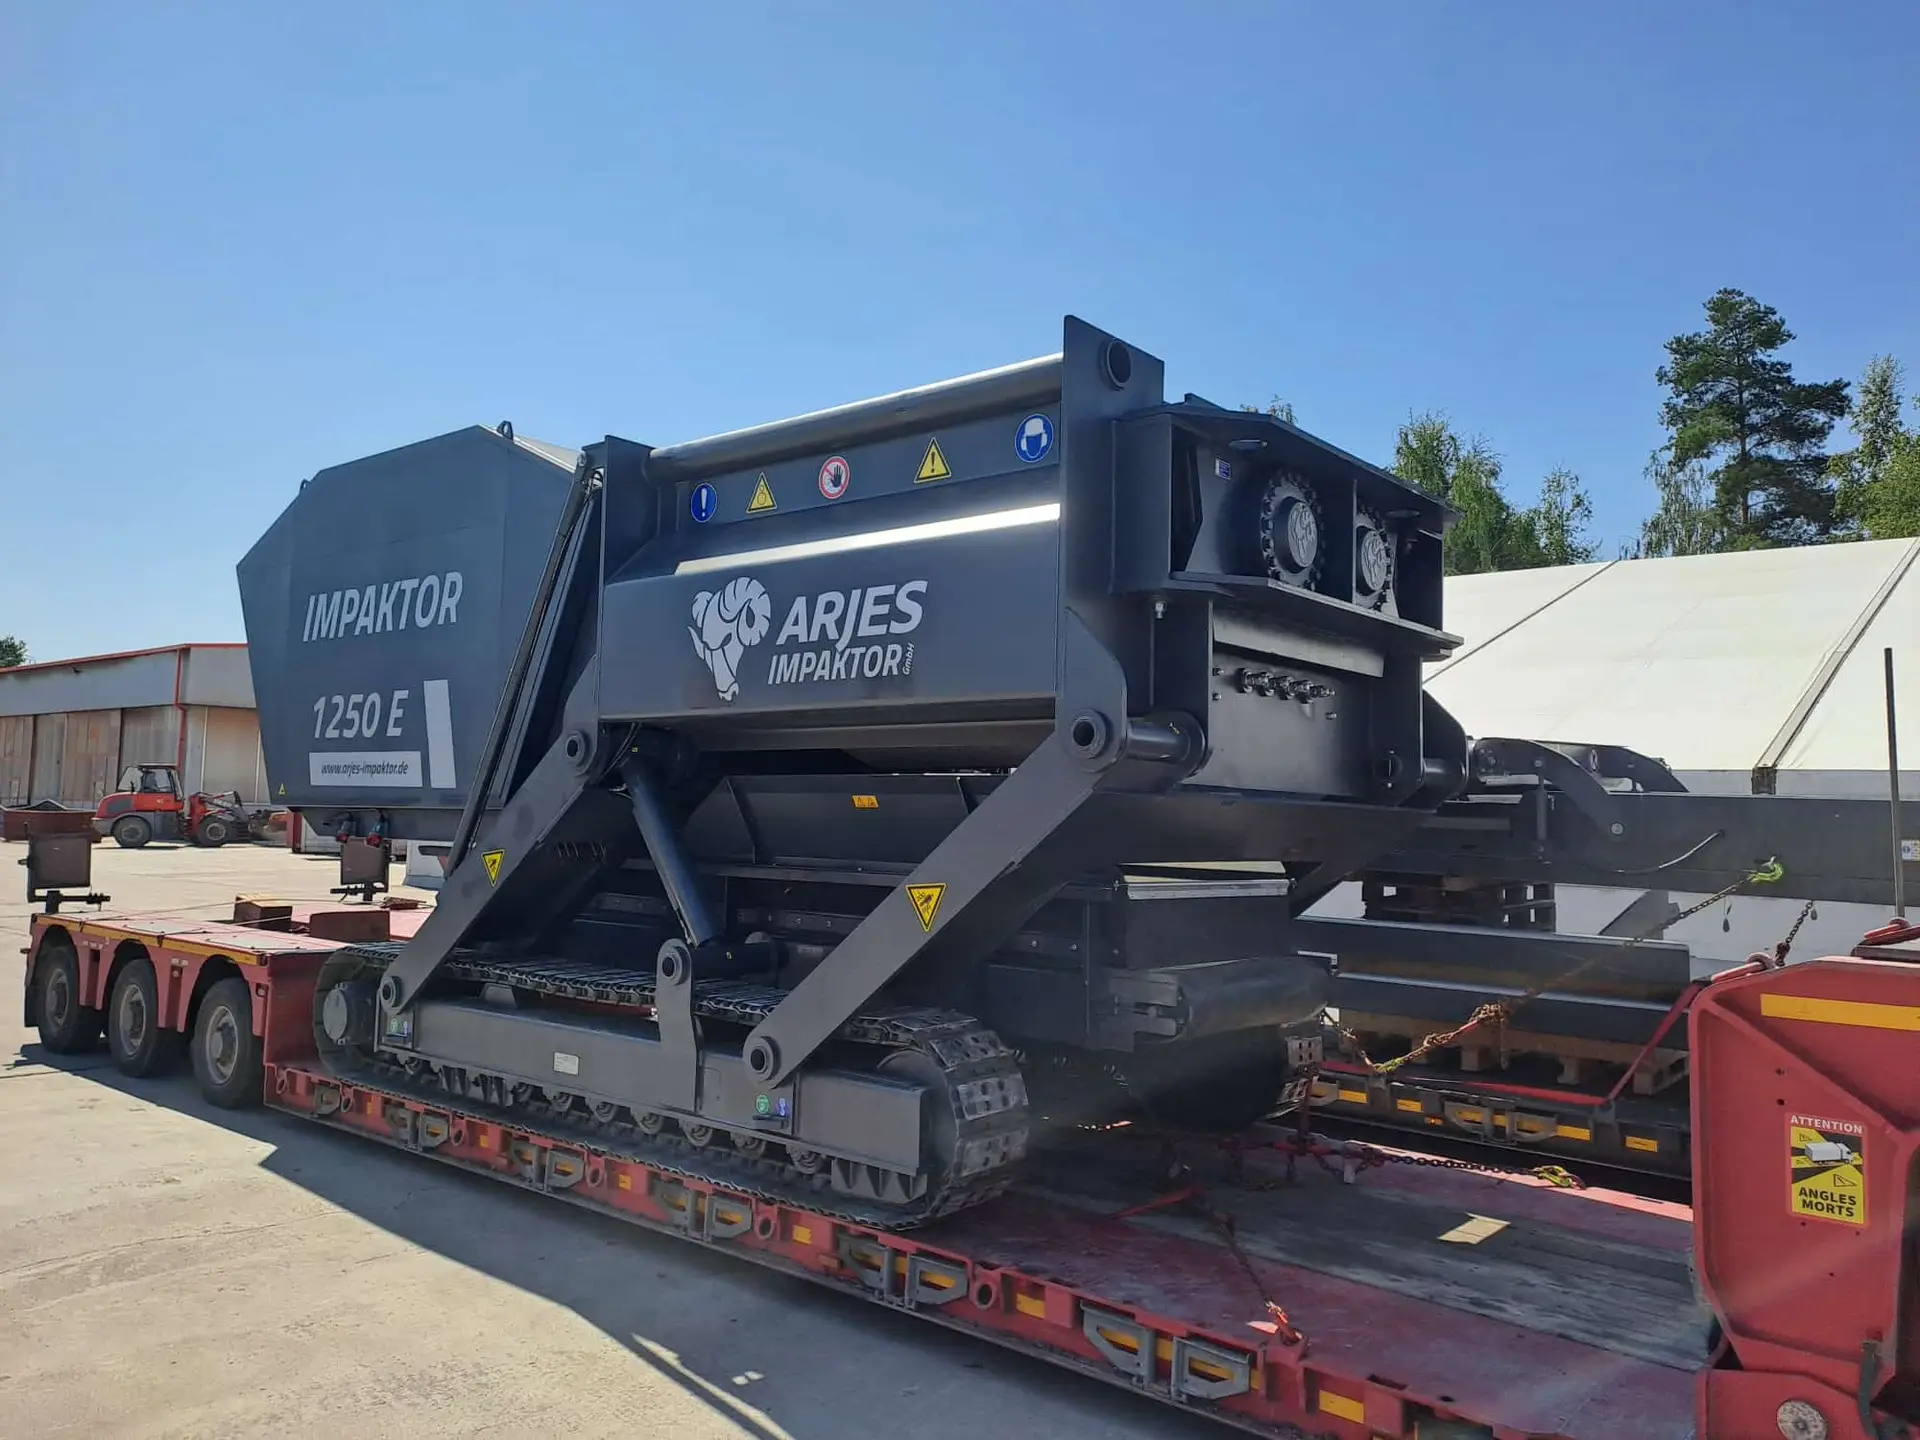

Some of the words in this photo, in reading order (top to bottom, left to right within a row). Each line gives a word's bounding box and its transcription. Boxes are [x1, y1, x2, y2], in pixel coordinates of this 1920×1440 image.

[302, 571, 463, 642] IMPAKTOR
[776, 580, 928, 651] ARJES
[767, 643, 902, 685] IMPAKTOR
[902, 642, 915, 675] GmbH
[313, 692, 381, 739] 1250
[386, 689, 409, 737] E
[321, 761, 409, 778] www.arjes-impaktor.de
[1790, 1115, 1863, 1134] ATTENTION
[1798, 1187, 1857, 1206] ANGLES
[1801, 1199, 1854, 1217] MORTS
